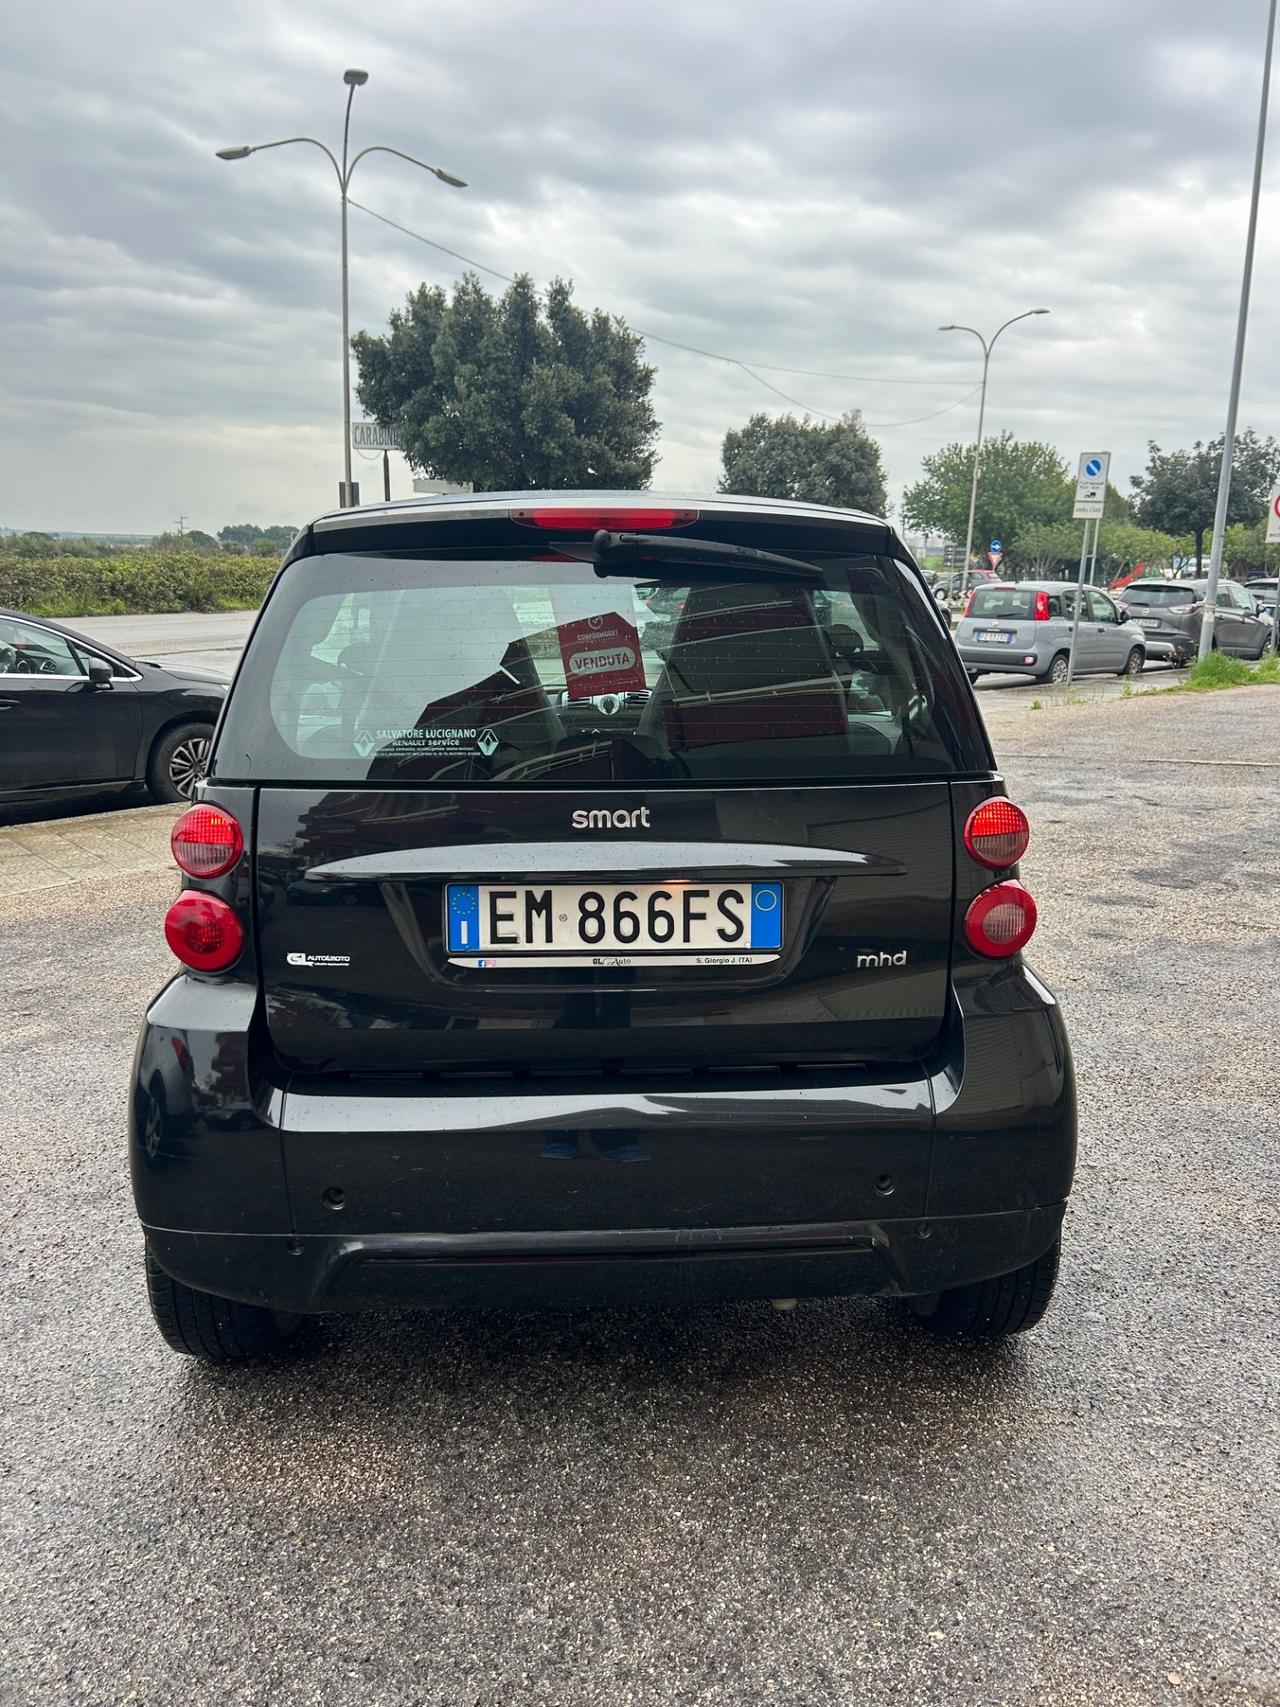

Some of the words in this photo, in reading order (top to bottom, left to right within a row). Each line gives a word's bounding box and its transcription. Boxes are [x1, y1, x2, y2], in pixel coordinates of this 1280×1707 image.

[574, 652, 630, 669] VENDUTA
[376, 729, 423, 739] SALVATORE
[425, 729, 477, 738] LUCIGNANO
[427, 737, 460, 746] service
[572, 806, 650, 829] smart
[489, 889, 553, 944] EM
[578, 889, 745, 944] 866FS
[704, 957, 730, 965] Giorgio
[738, 956, 753, 964] (TA)
[857, 950, 907, 968] mhd
